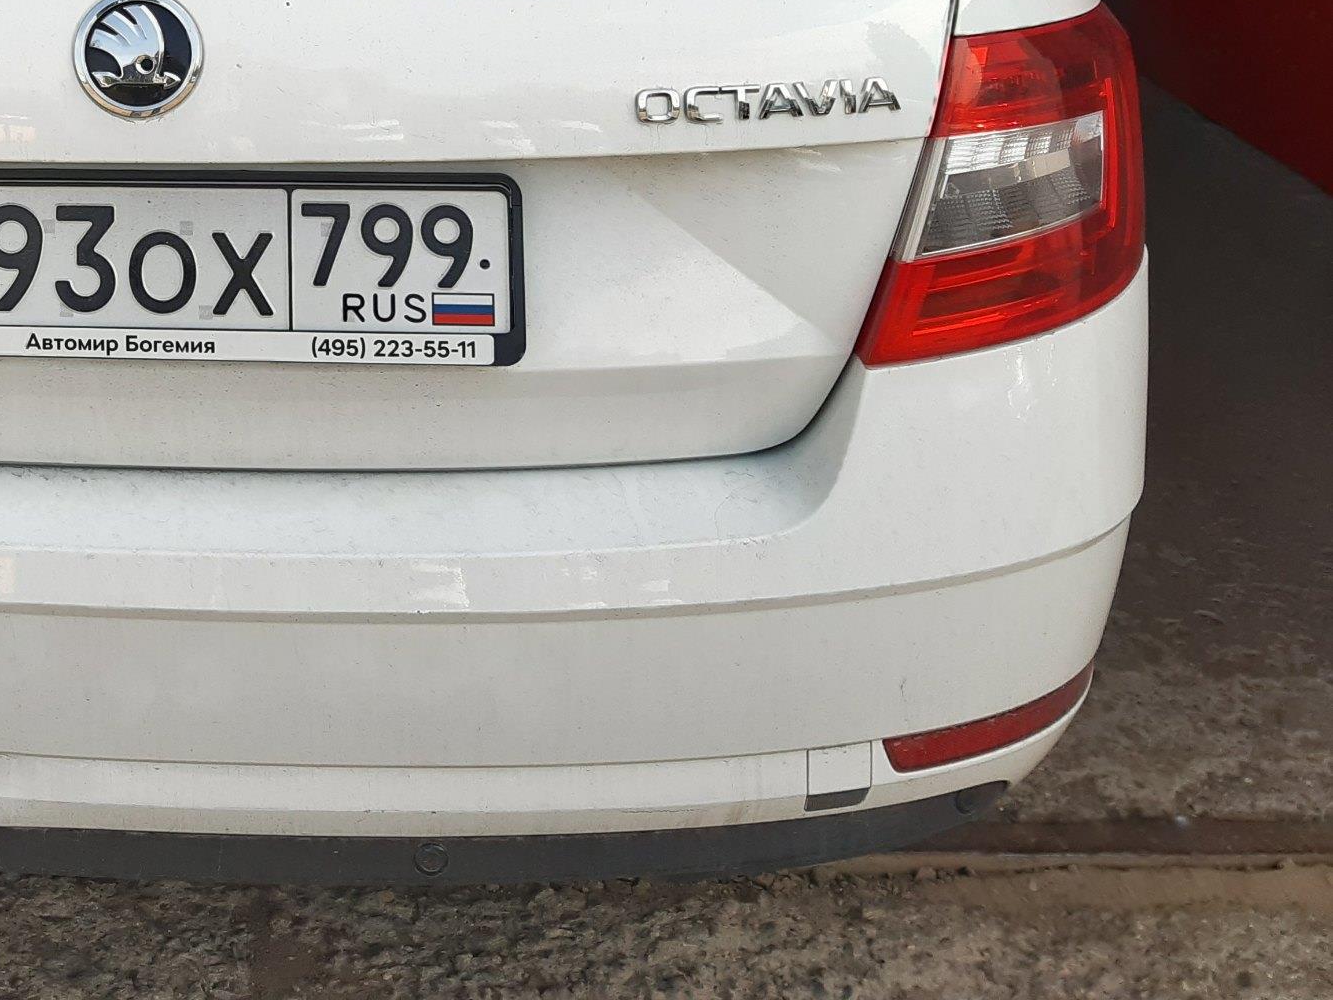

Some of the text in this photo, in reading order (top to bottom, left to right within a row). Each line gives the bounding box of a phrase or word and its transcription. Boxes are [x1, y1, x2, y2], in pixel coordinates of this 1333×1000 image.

[635, 76, 902, 124] OCTAVIA
[301, 203, 473, 289] 799
[342, 293, 427, 324] RUS
[25, 332, 216, 355] Автомир Богемия
[311, 336, 476, 359] (495) 223-55-11
